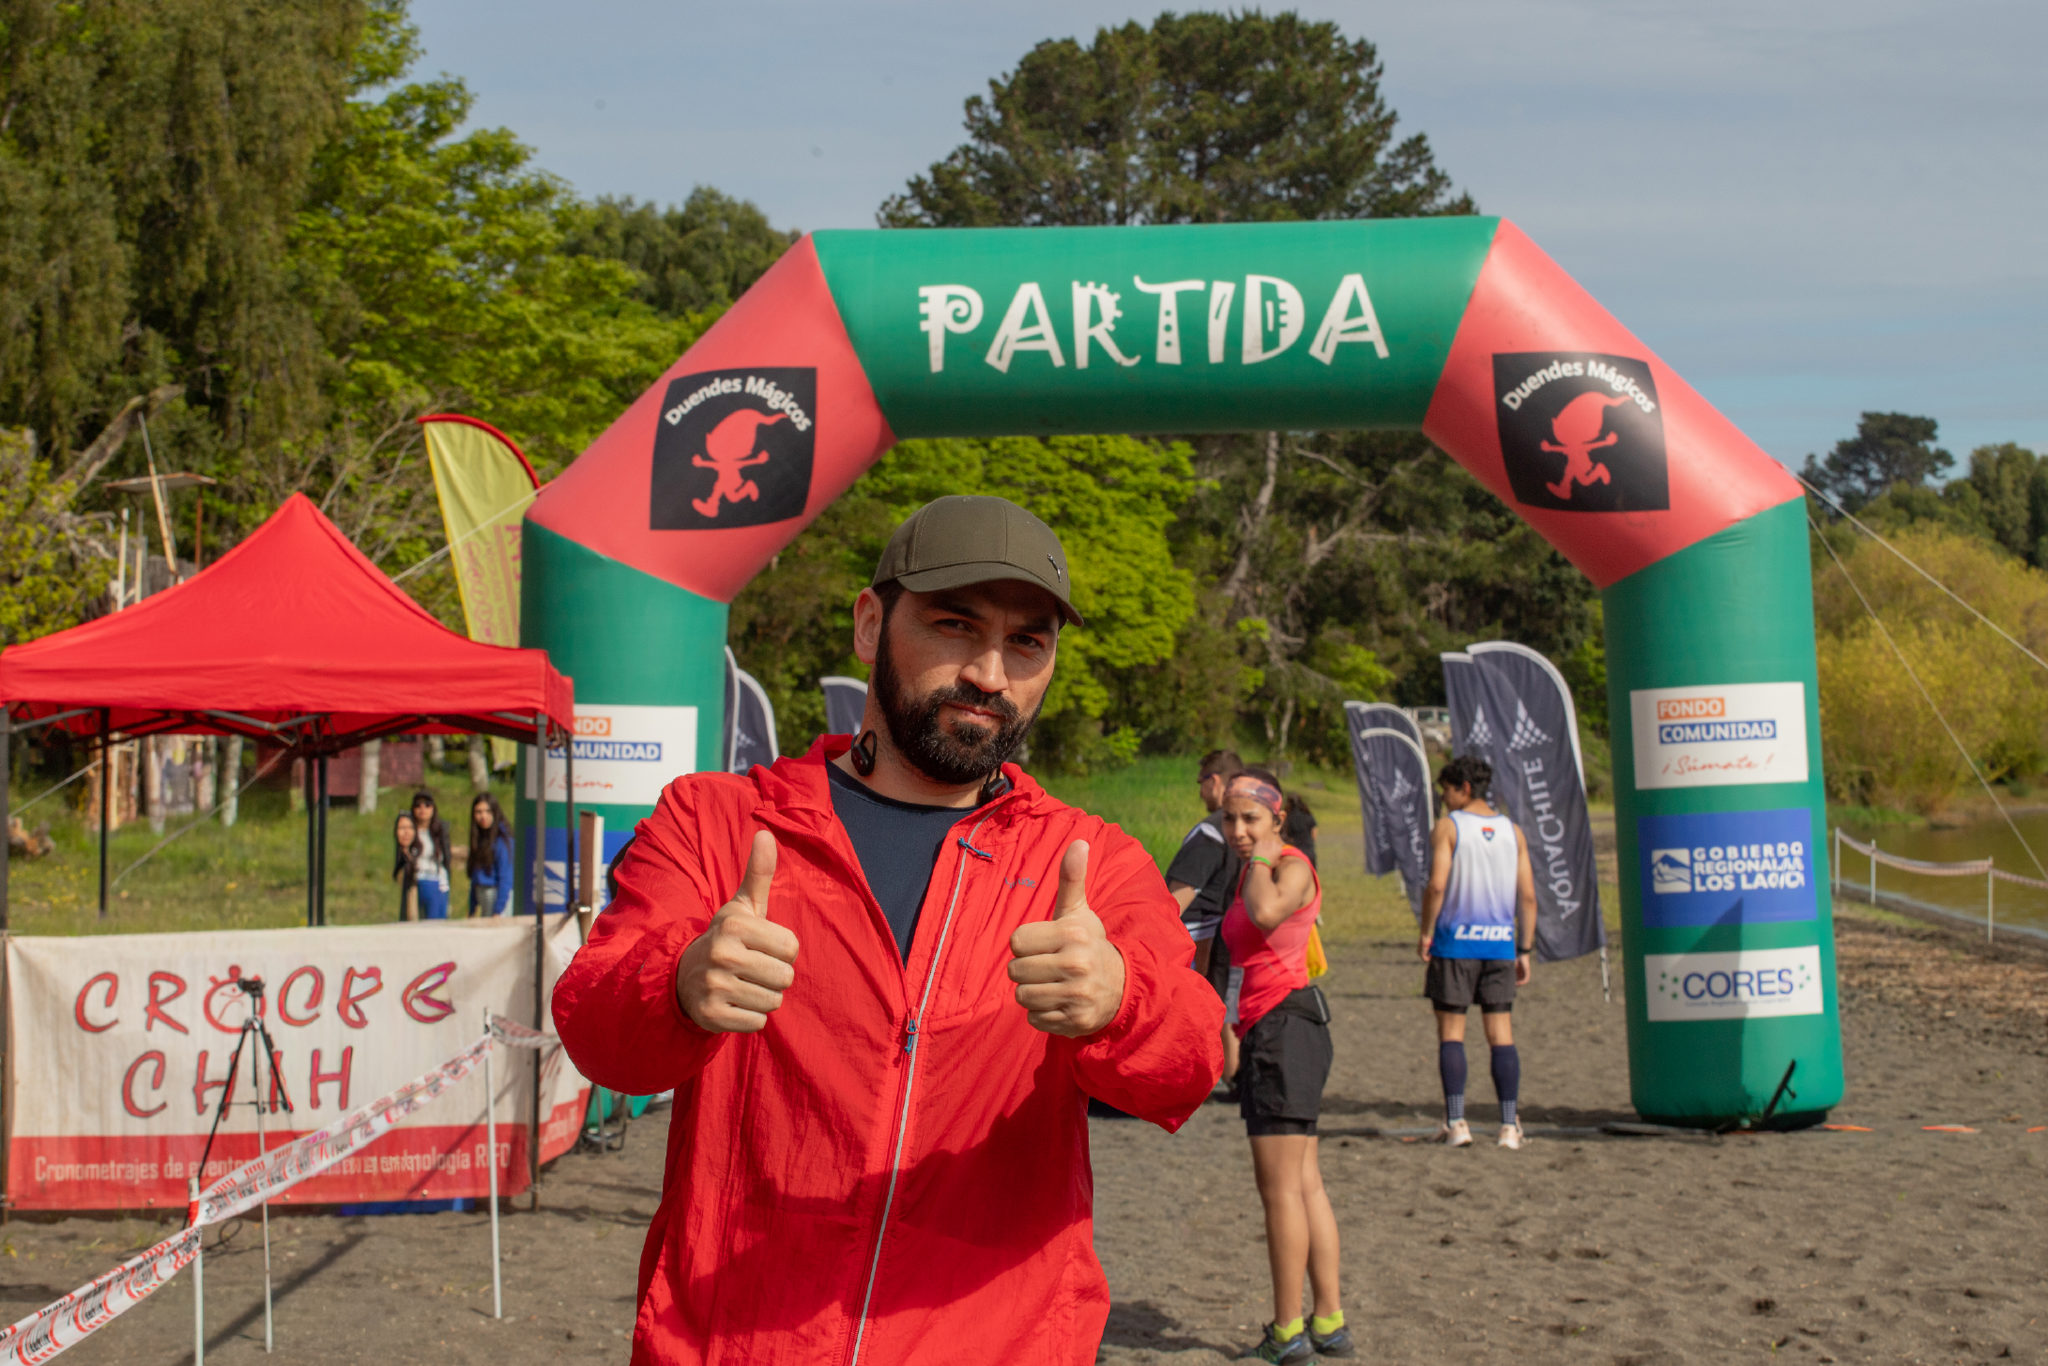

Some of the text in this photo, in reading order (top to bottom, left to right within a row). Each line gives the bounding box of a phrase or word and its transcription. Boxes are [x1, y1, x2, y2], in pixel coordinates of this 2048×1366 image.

[918, 273, 1390, 373] PARTIDA
[1502, 359, 1656, 413] Duendes Mágicos
[664, 375, 812, 432] Duendes Mágicos
[1660, 699, 1721, 717] FONDO
[1661, 721, 1774, 743] COMUNIDAD
[1694, 874, 1735, 892] LOS
[1682, 968, 1793, 999] CORES
[34, 1155, 158, 1185] Cronometrajes
[163, 1155, 184, 1179] de
